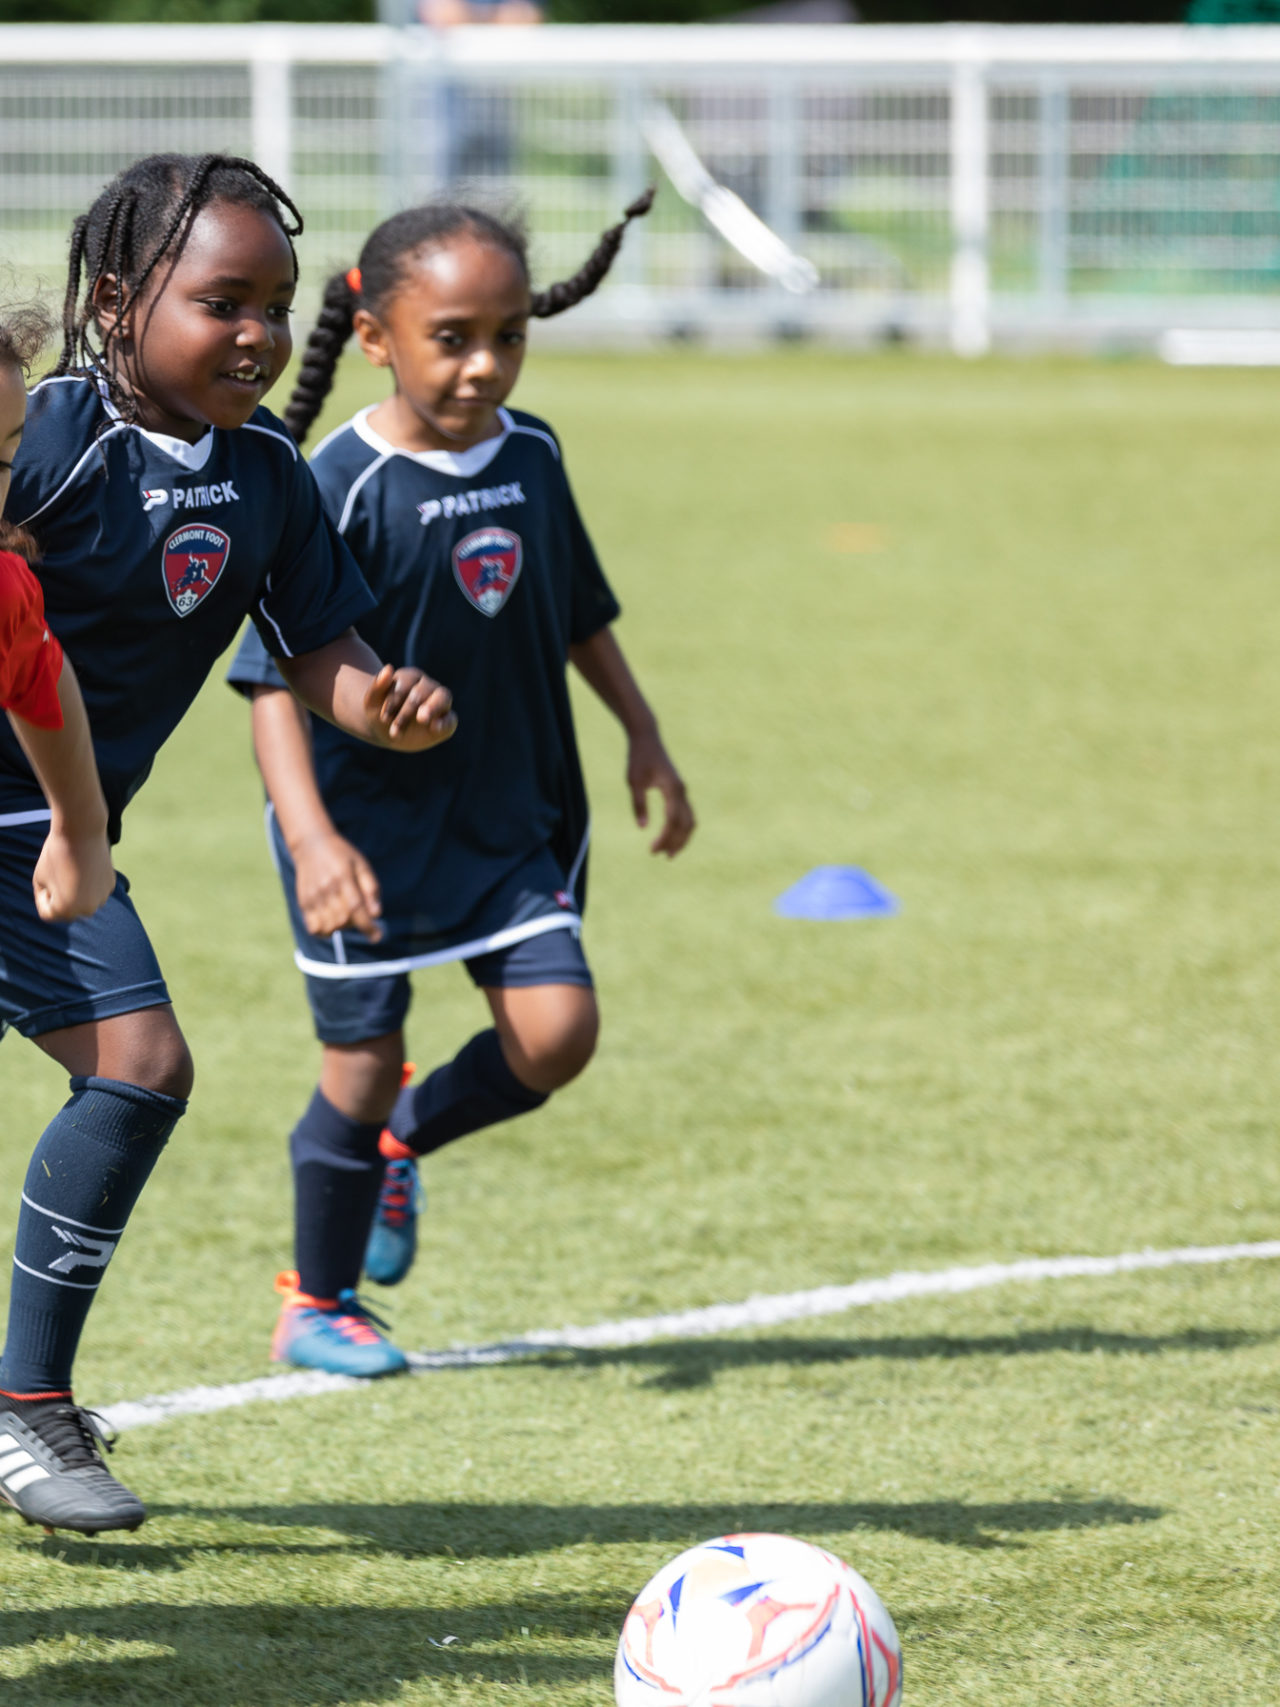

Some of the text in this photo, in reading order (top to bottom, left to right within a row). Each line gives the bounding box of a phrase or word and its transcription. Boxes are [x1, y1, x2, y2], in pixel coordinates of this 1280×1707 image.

[172, 480, 240, 509] PATRICK
[441, 481, 526, 519] PATRICK
[168, 529, 225, 550] CLERMONT FOOT
[178, 596, 194, 607] 63
